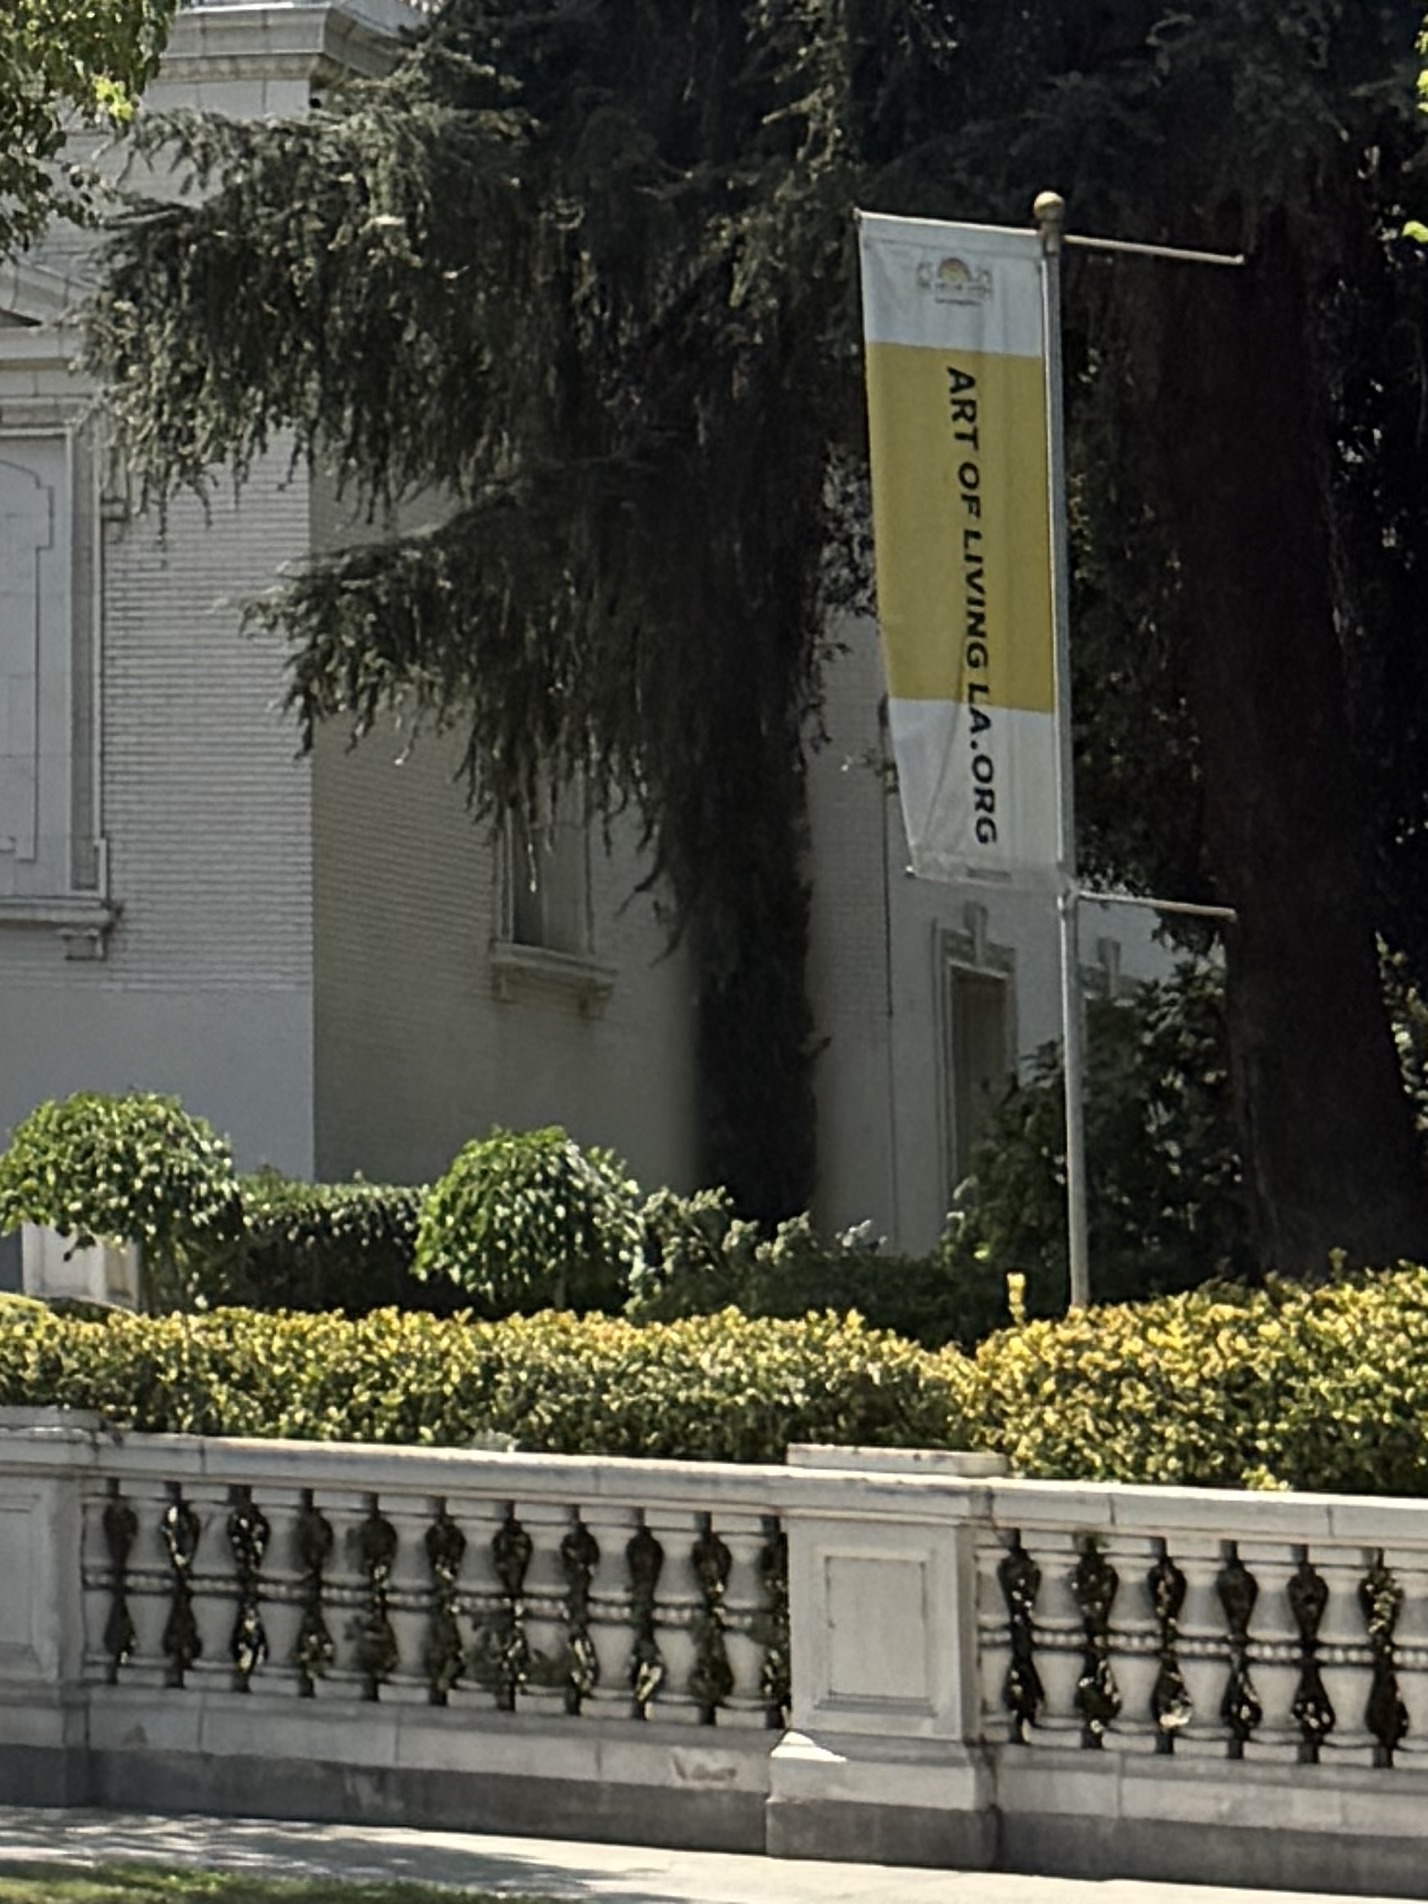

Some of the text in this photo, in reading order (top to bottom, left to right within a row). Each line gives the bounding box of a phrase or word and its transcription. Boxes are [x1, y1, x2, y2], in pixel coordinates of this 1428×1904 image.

[947, 366, 998, 845] ART OF LIVING LA.ORG
